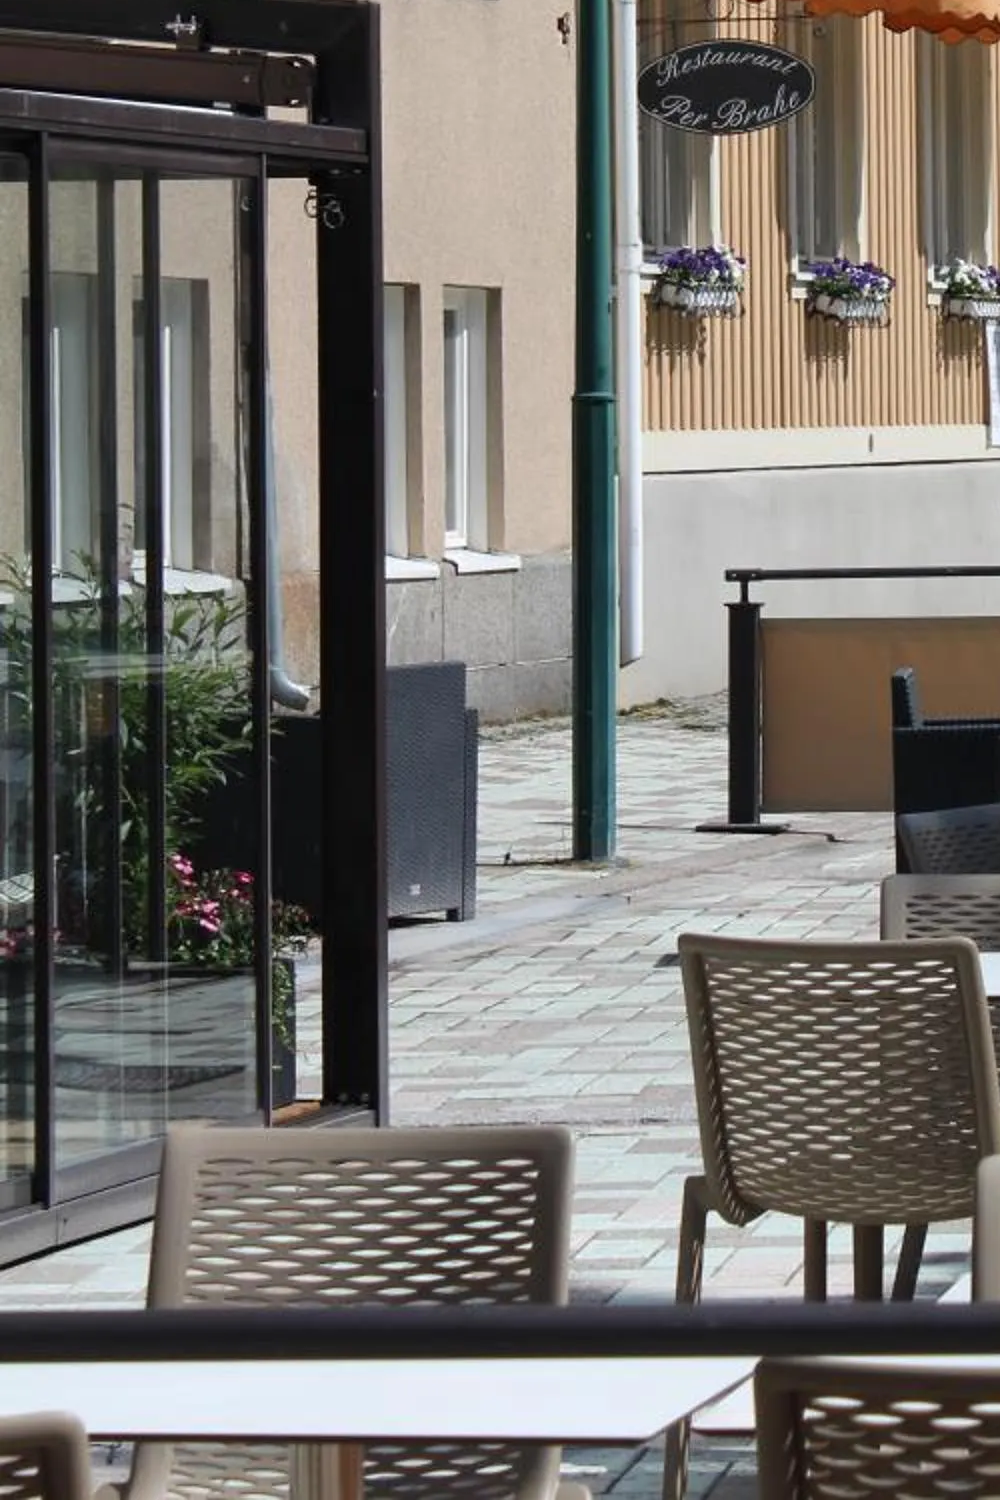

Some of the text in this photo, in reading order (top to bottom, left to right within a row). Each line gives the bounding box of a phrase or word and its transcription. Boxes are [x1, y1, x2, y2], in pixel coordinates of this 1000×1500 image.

[656, 48, 800, 87] Restaurant
[653, 83, 800, 129] Per Brahe
